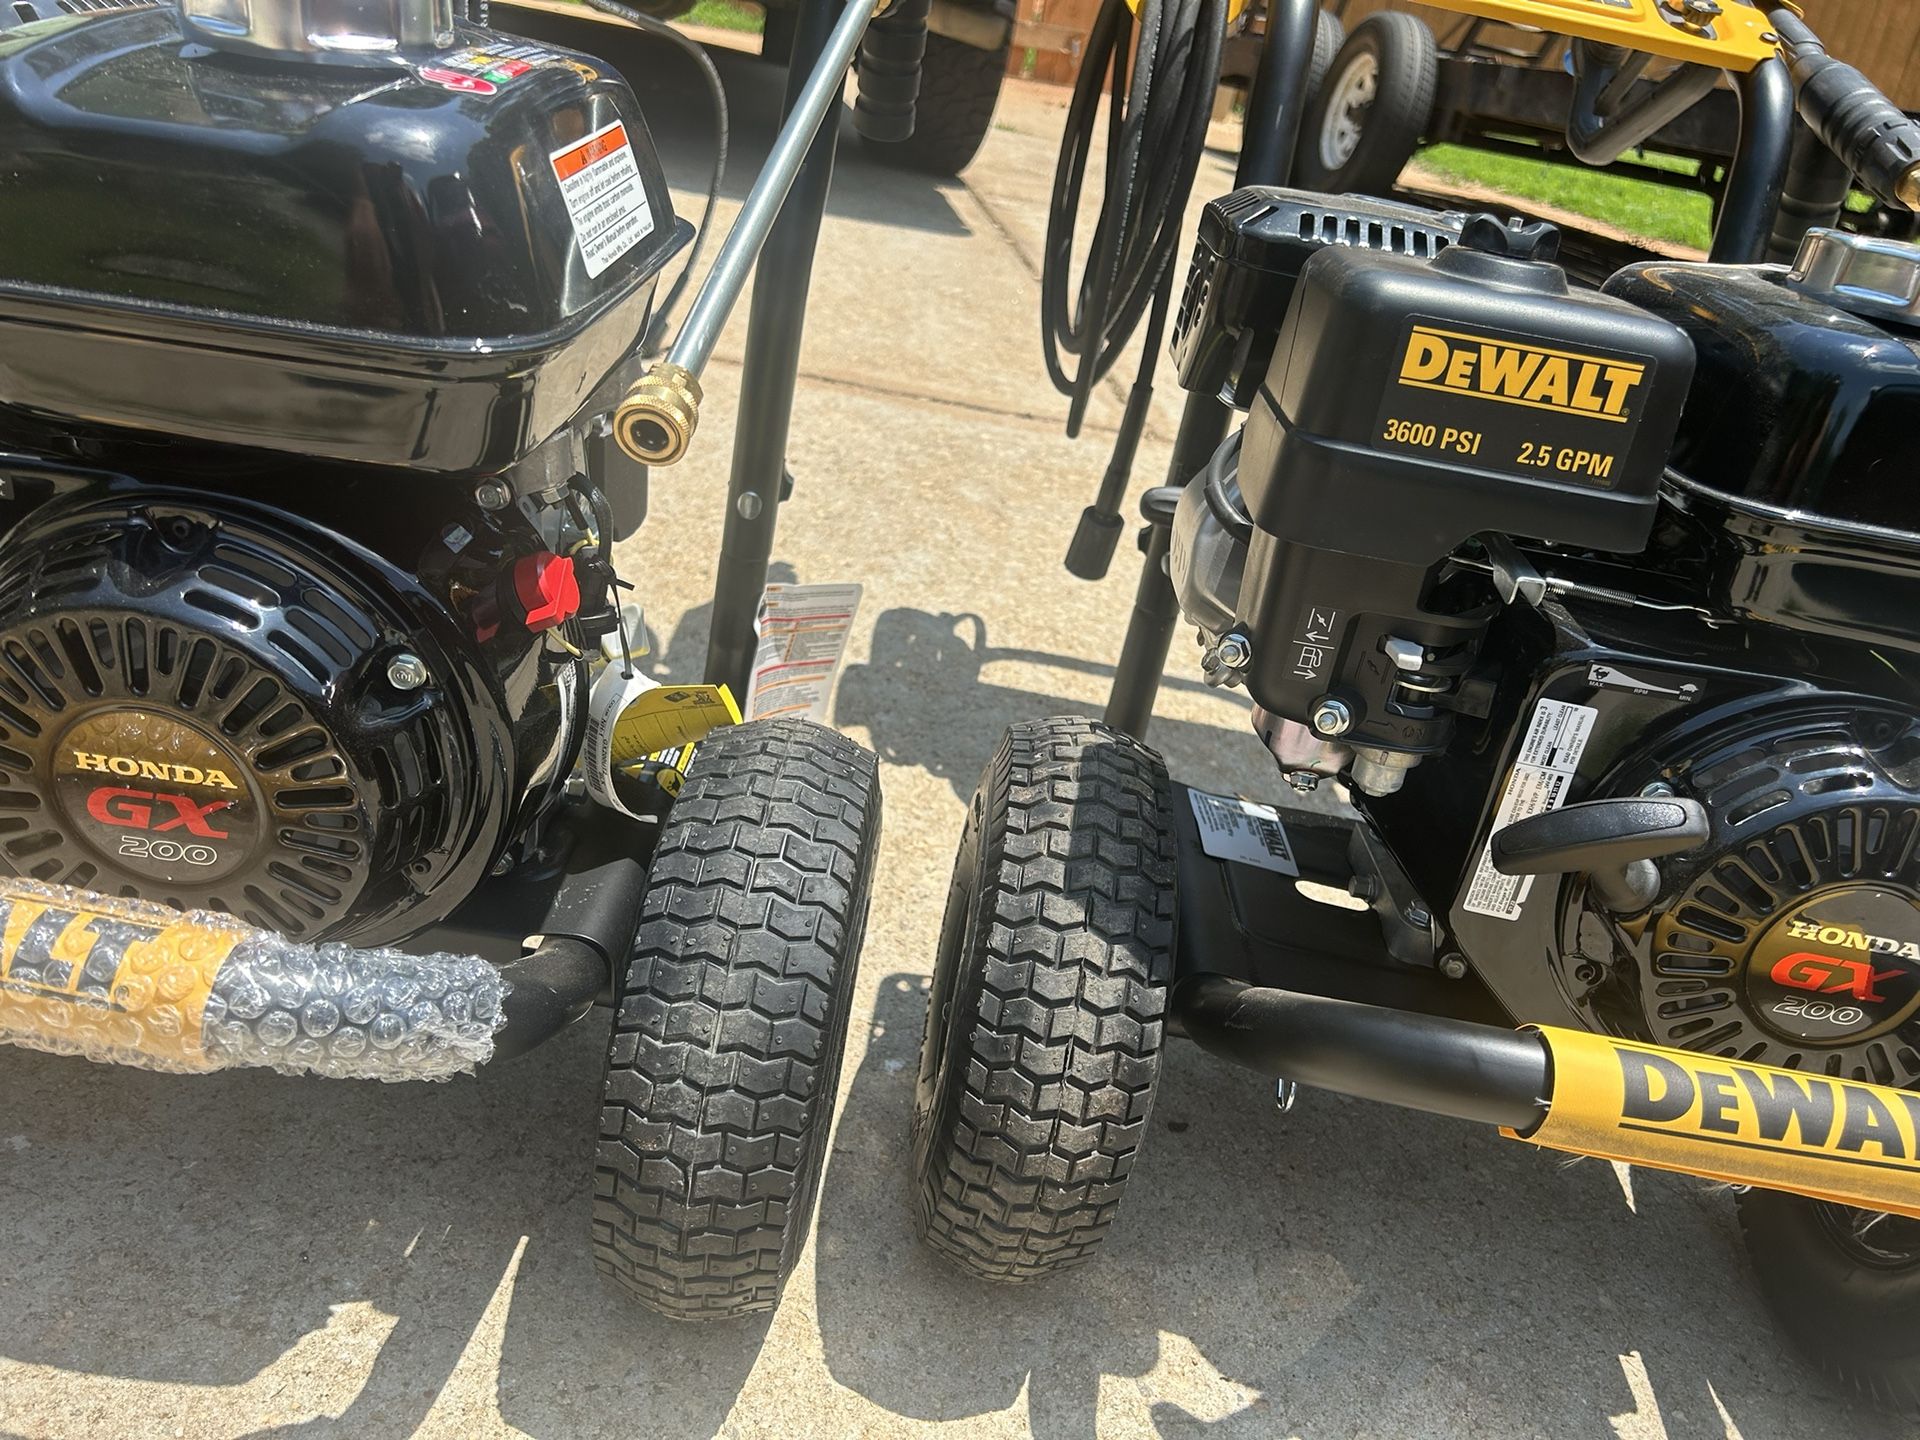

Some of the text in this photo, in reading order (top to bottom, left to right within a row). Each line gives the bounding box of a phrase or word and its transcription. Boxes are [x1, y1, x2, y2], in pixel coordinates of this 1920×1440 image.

[1383, 418, 1614, 478] 3600 PSI 2.5 GPM
[73, 751, 238, 790] HONDA
[86, 786, 236, 840] GX
[118, 835, 218, 866] 200
[1787, 920, 1920, 961] HONDA
[1771, 952, 1908, 1003] GX
[1773, 995, 1863, 1025] 200
